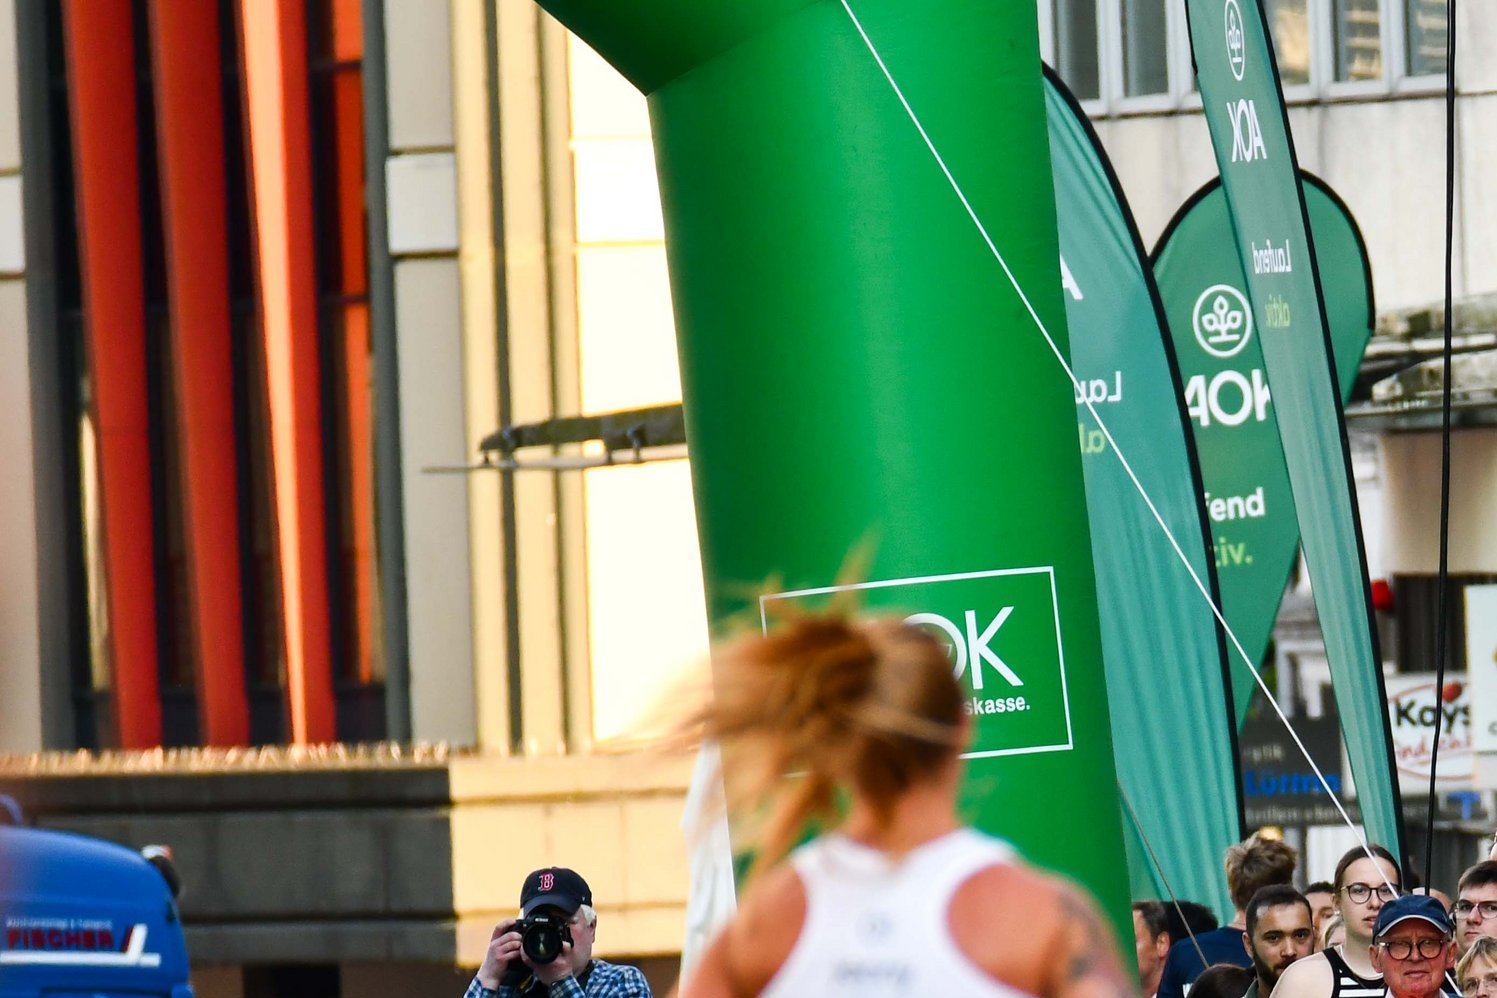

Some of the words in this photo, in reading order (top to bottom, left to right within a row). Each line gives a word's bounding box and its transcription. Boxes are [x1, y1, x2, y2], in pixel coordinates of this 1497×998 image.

[903, 605, 1025, 690] OK
[964, 695, 1031, 716] skasse.
[7, 928, 114, 949] FISCHER
